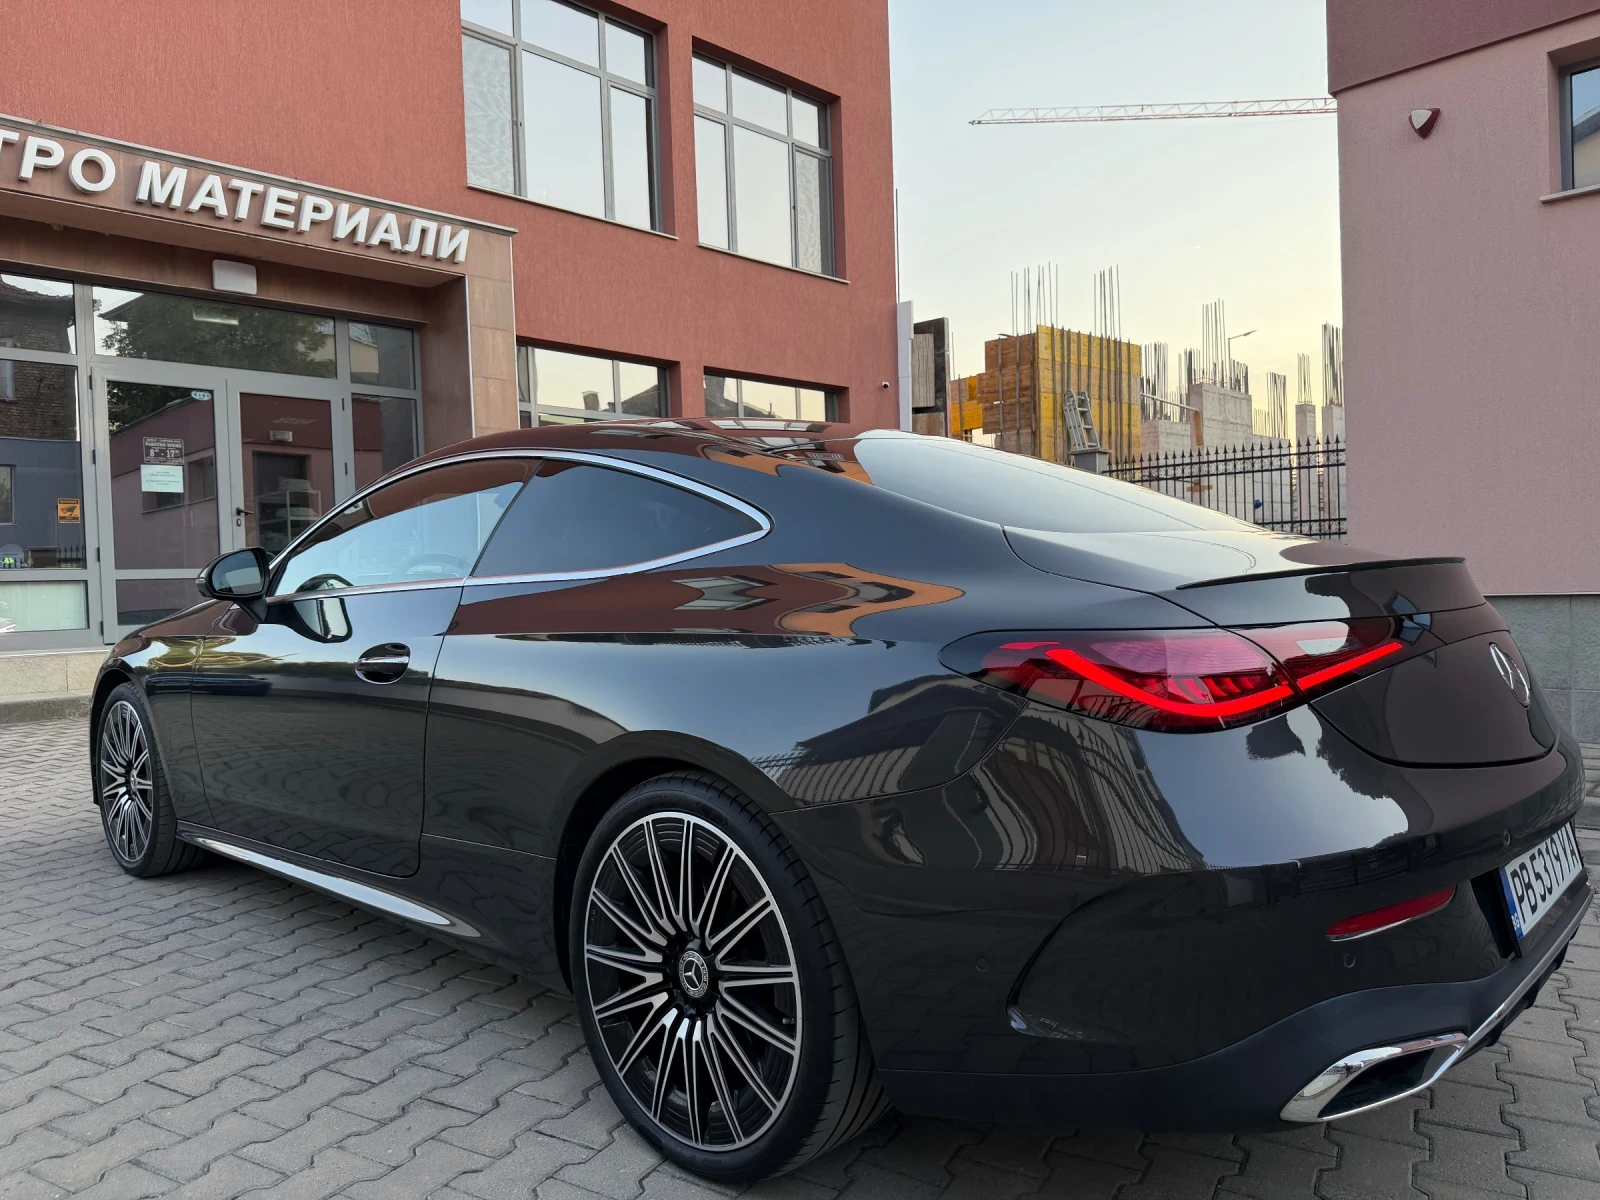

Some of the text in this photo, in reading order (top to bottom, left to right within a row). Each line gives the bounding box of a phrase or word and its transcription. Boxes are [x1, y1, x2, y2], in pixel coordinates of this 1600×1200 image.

[136, 160, 470, 264] МАТЕРИАЛИ
[1510, 861, 1538, 924] PB
[1529, 836, 1564, 902] 5319
